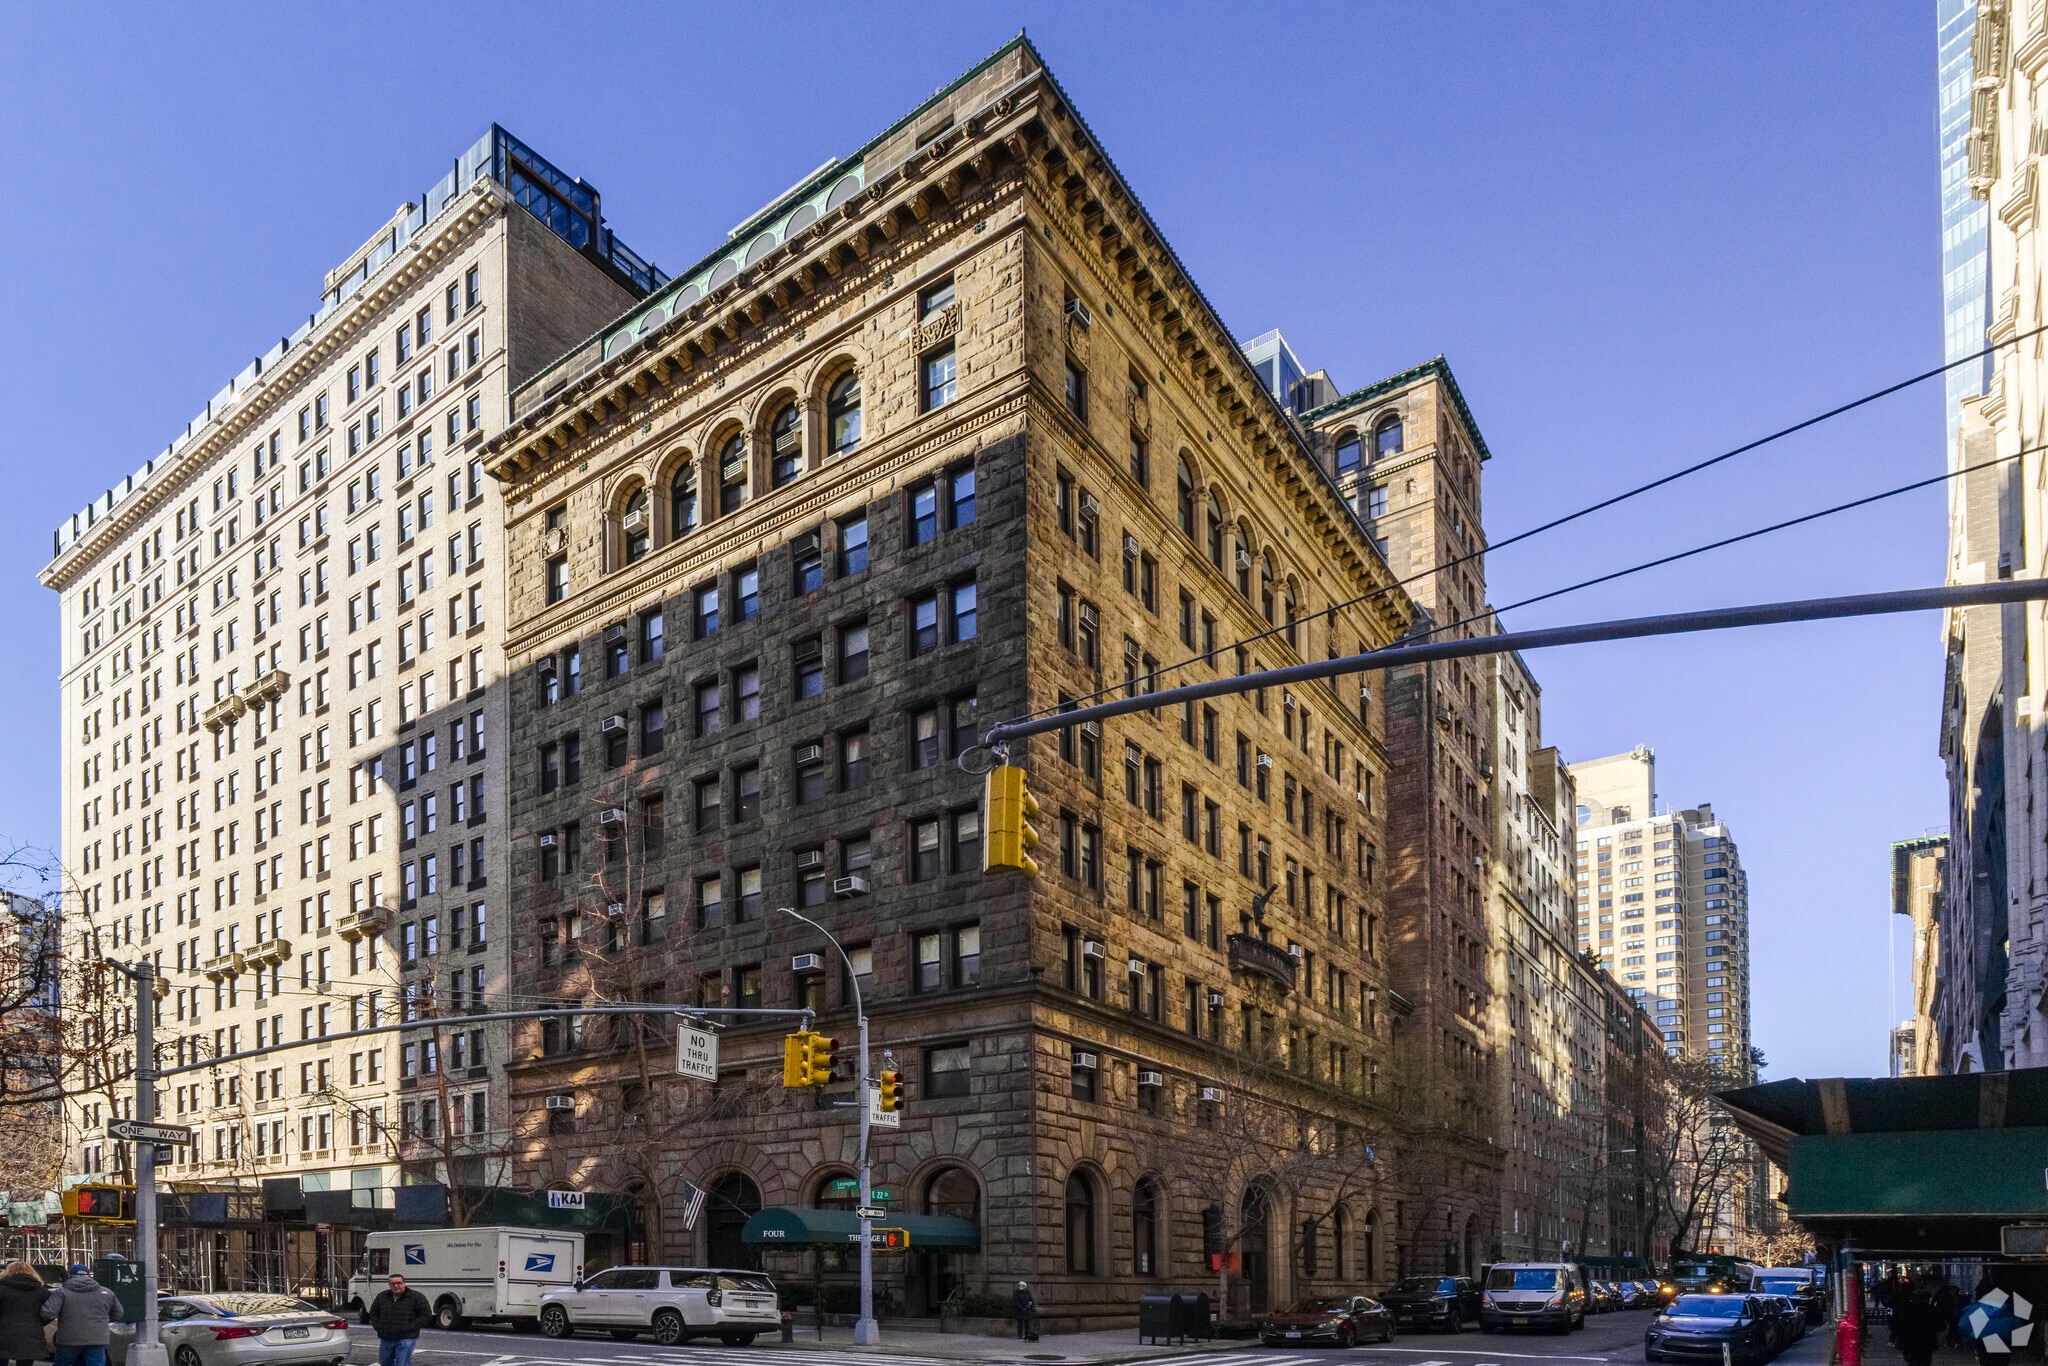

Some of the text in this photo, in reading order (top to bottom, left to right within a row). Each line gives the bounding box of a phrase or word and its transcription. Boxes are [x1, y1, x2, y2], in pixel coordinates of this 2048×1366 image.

[690, 1034, 706, 1048] NO
[688, 1048, 708, 1062] THRU
[682, 1059, 713, 1075] TRAFFIC
[872, 1113, 896, 1123] TRAFFIC
[120, 1125, 184, 1140] ONE WAY
[160, 1150, 172, 1159] WAY
[562, 1193, 582, 1205] KAJ
